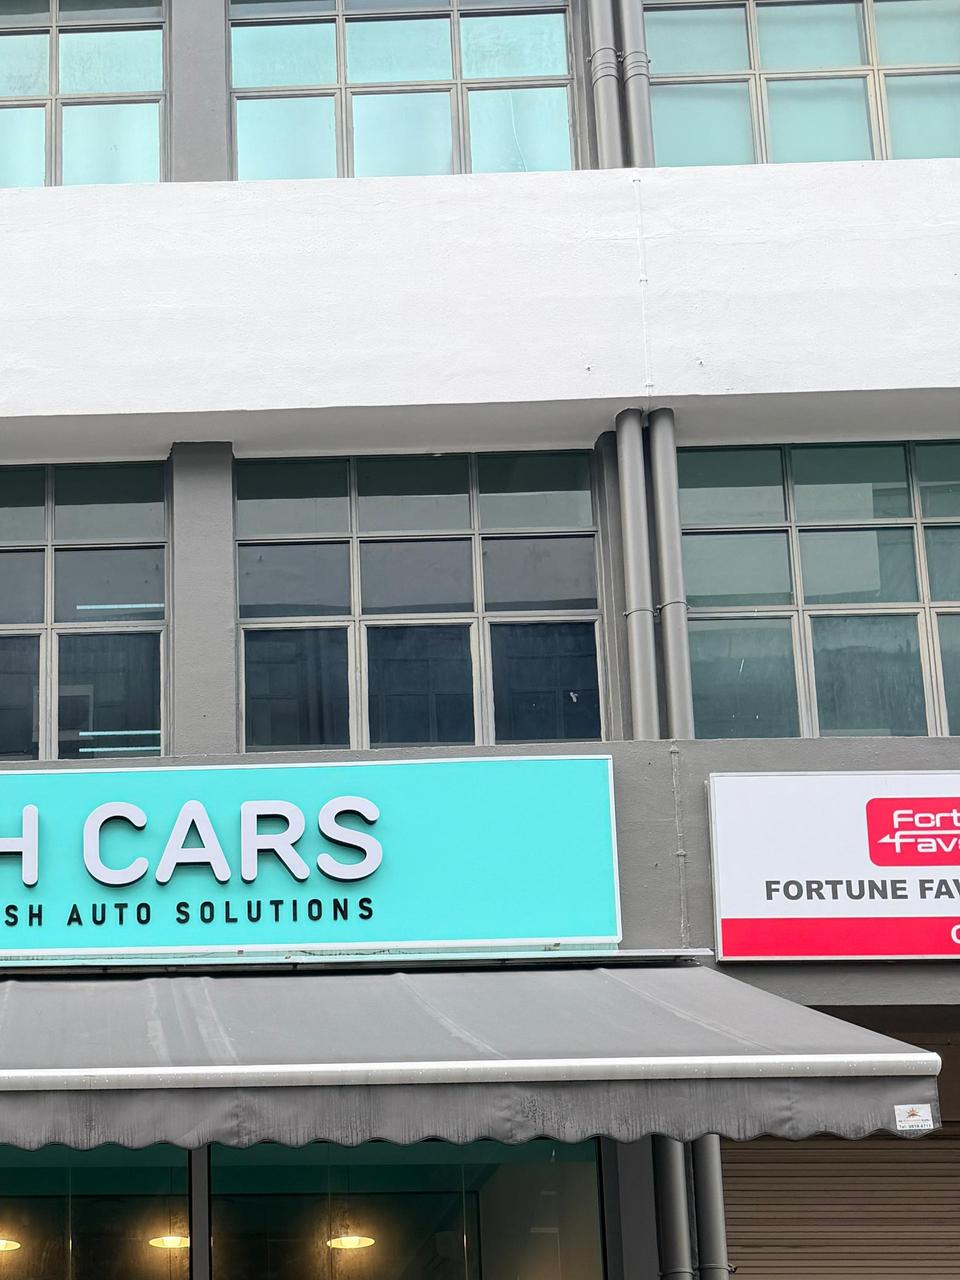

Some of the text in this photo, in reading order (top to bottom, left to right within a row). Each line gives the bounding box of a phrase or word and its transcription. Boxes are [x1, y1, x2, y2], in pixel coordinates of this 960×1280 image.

[83, 795, 384, 888] CARS
[765, 879, 909, 901] FORTUNE
[66, 902, 152, 926] AUTO
[175, 897, 375, 924] SOLUTIONS
